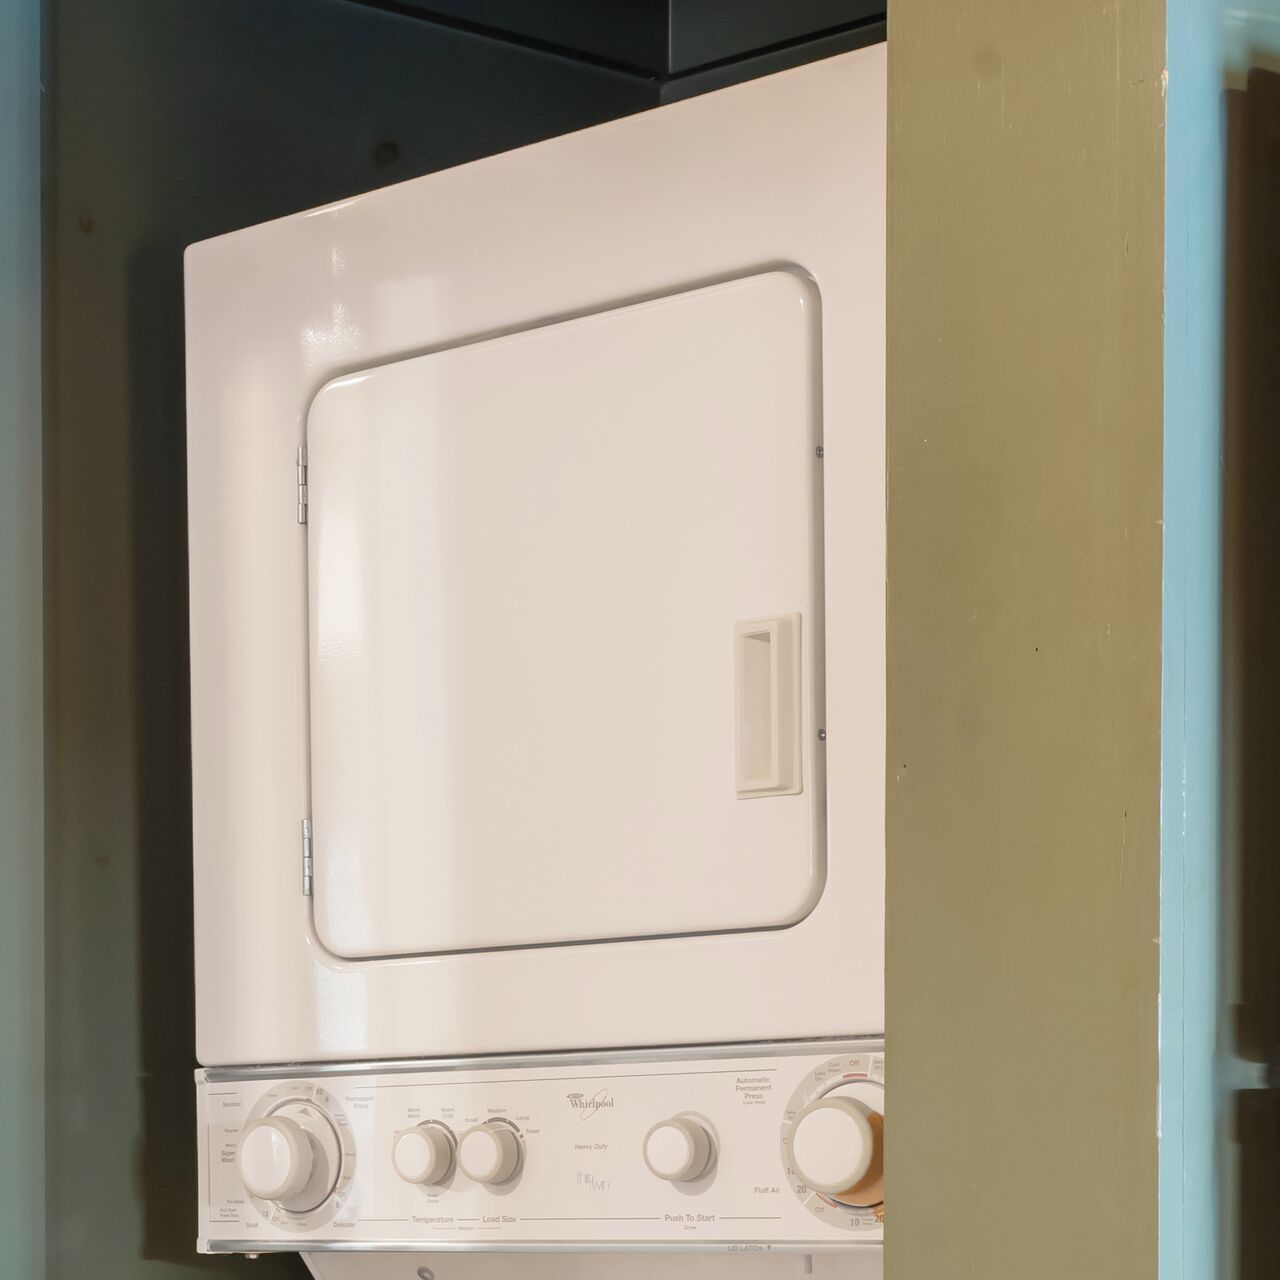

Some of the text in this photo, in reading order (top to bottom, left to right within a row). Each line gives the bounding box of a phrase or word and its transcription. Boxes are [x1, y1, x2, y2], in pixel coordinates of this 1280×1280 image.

[569, 1097, 614, 1110] Whirlpool
[594, 1143, 608, 1151] Duty
[797, 1185, 807, 1194] 20
[412, 1215, 454, 1224] Temperature
[482, 1215, 516, 1223] Load Size
[664, 1214, 715, 1222] Push To Start
[850, 1218, 860, 1227] 10
